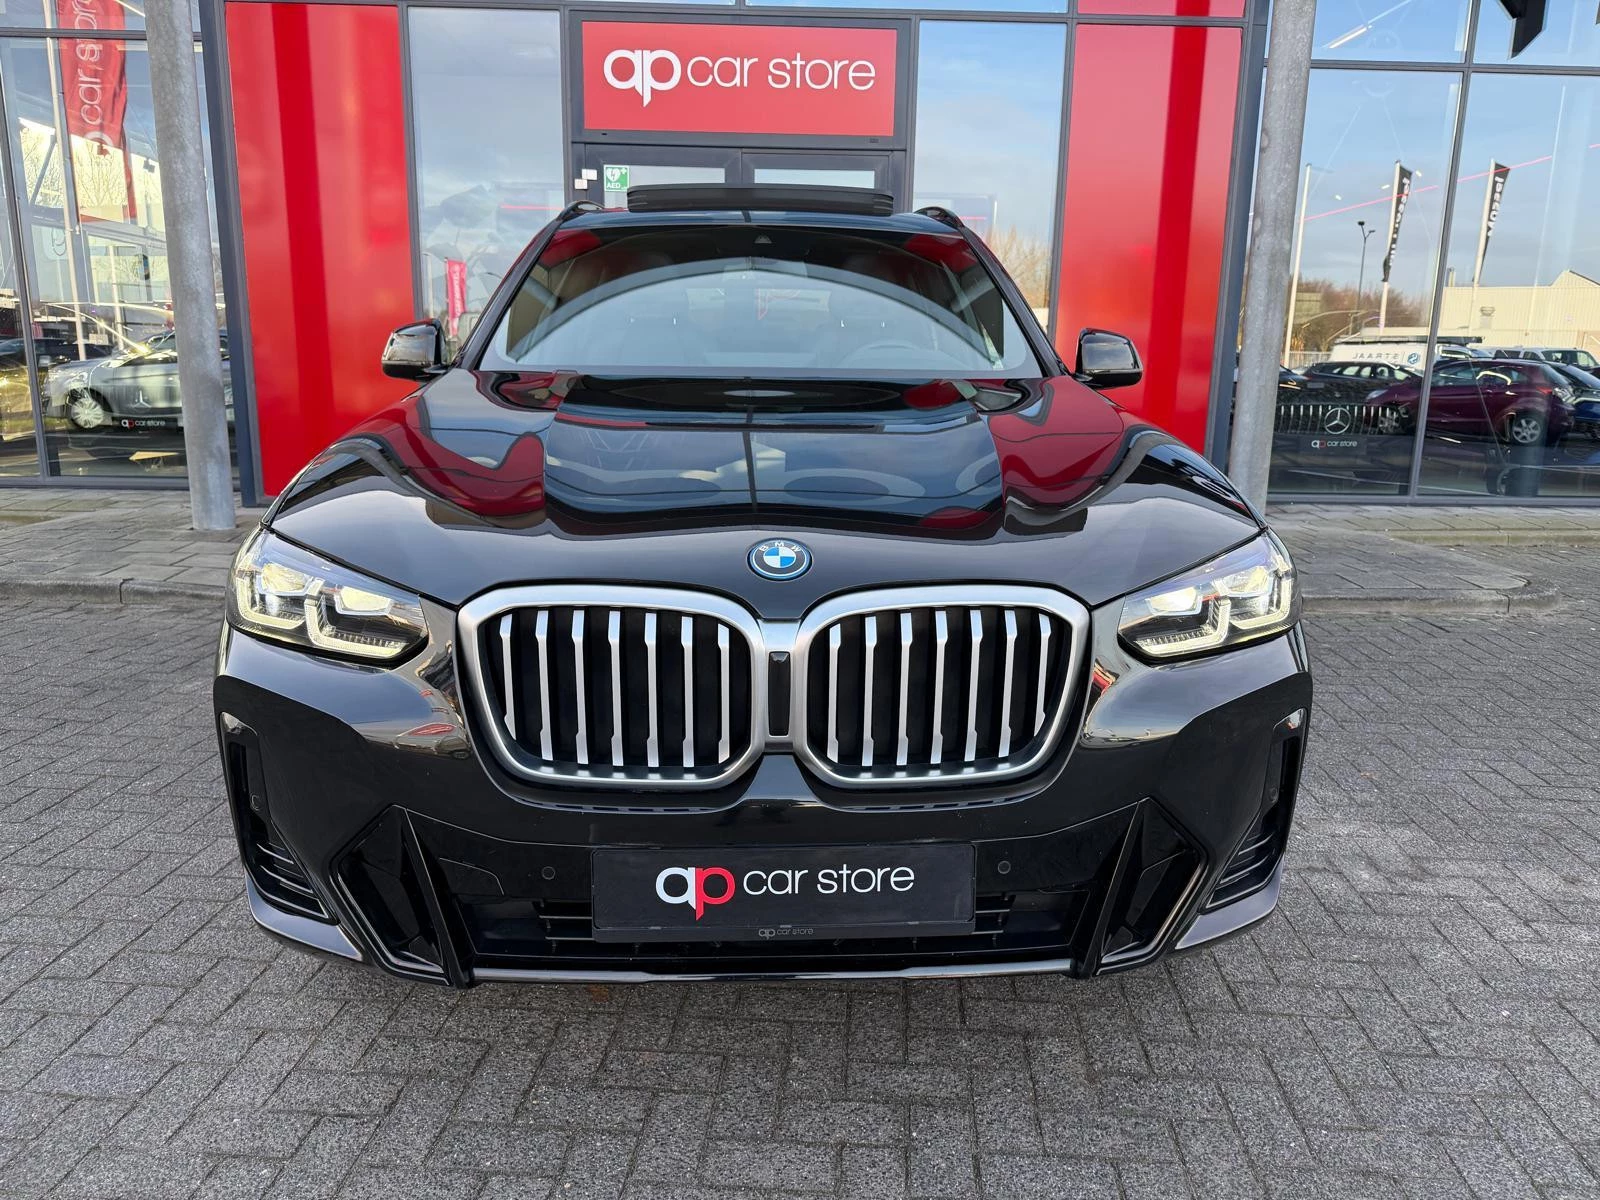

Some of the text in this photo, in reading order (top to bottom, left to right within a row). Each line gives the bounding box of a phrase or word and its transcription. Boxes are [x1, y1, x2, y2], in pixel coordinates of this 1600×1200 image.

[687, 56, 759, 88] car
[767, 52, 876, 91] store
[606, 182, 621, 190] AED
[759, 541, 802, 552] BMW
[743, 869, 808, 896] car
[816, 863, 915, 895] store
[792, 927, 814, 935] store
